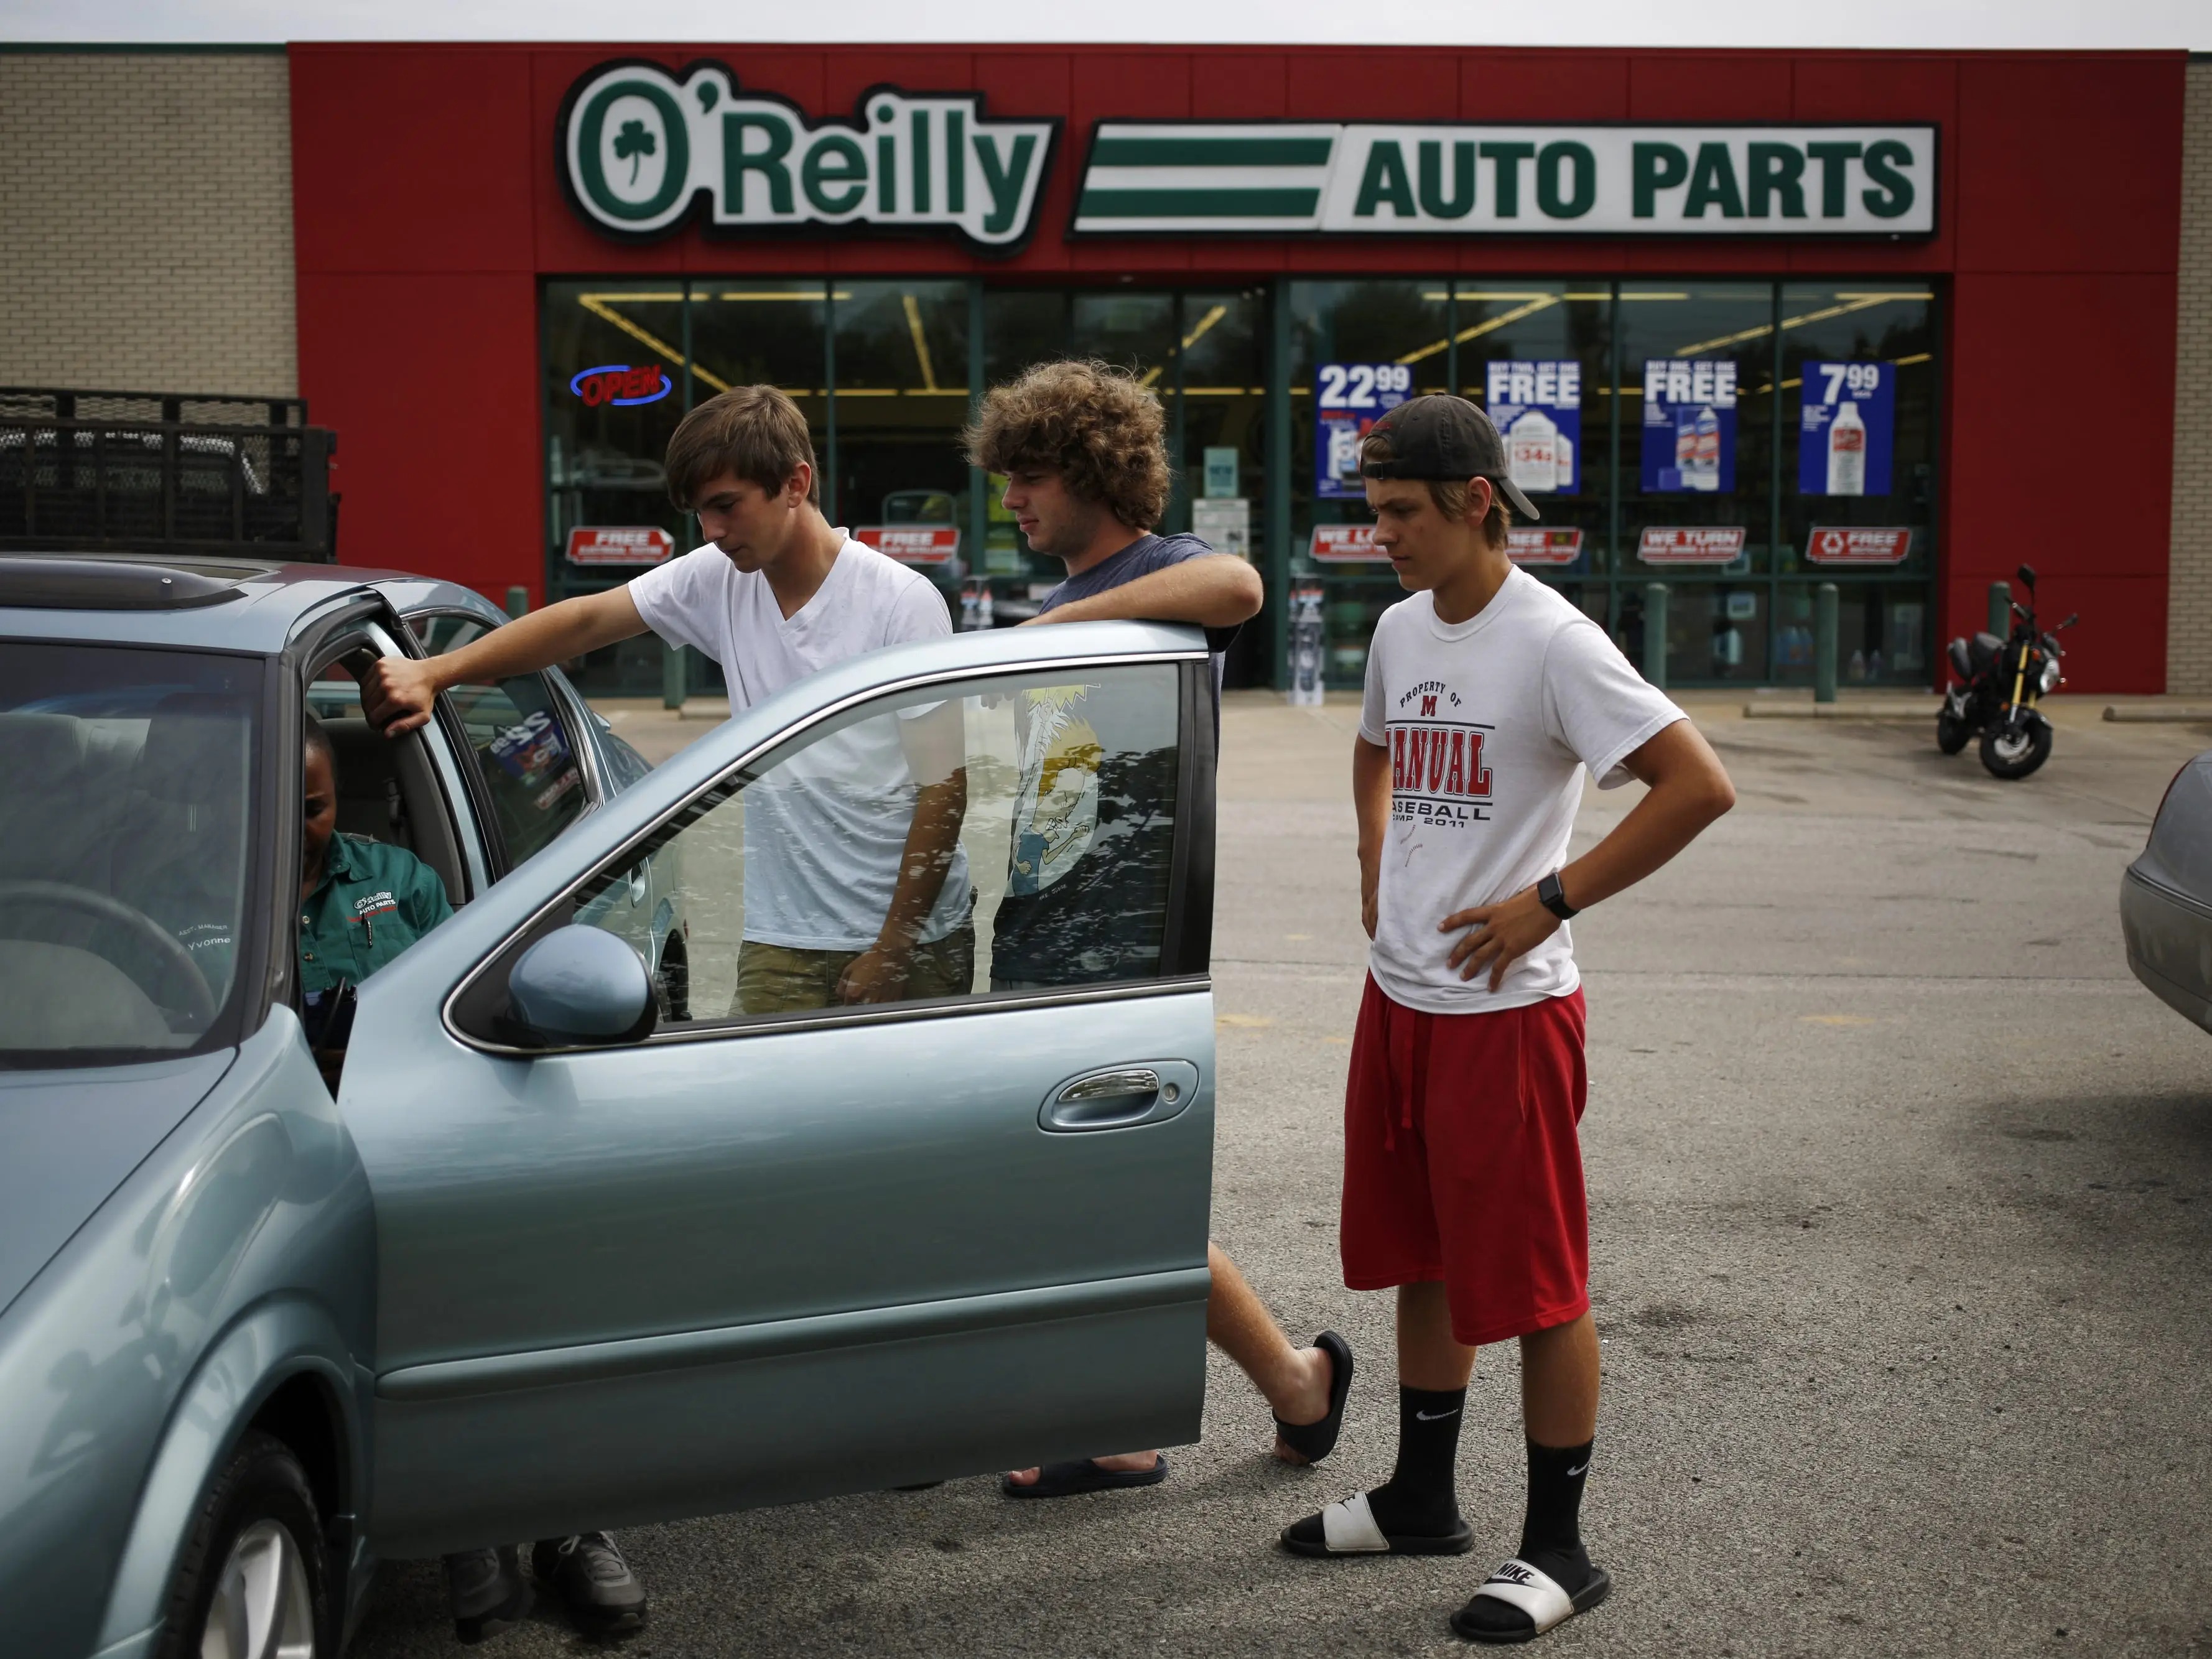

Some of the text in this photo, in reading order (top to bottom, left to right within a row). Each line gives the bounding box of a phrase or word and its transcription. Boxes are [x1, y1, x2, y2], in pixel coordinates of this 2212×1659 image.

[578, 79, 1038, 234] O'Reilly
[1353, 139, 1915, 219] AUTO PARTS
[582, 365, 661, 406] OPEN
[1488, 373, 1581, 404] FREE
[1645, 373, 1737, 404] FREE
[596, 531, 650, 545] FREE
[880, 531, 934, 546] FREE
[1319, 529, 1349, 543] WE
[1507, 532, 1545, 546] REE
[1648, 531, 1739, 546] WE TURN
[1847, 532, 1898, 546] FREE
[1400, 681, 1462, 708] PROPERTY OF
[1420, 695, 1438, 717] M
[1392, 801, 1490, 821] ASEBALL
[1423, 817, 1465, 829] 2011
[354, 891, 393, 909] O'Reilly
[359, 904, 376, 915] AUTO
[376, 899, 396, 908] PARTS
[187, 937, 231, 951] Yvonne
[1494, 1562, 1536, 1586] NIKE
